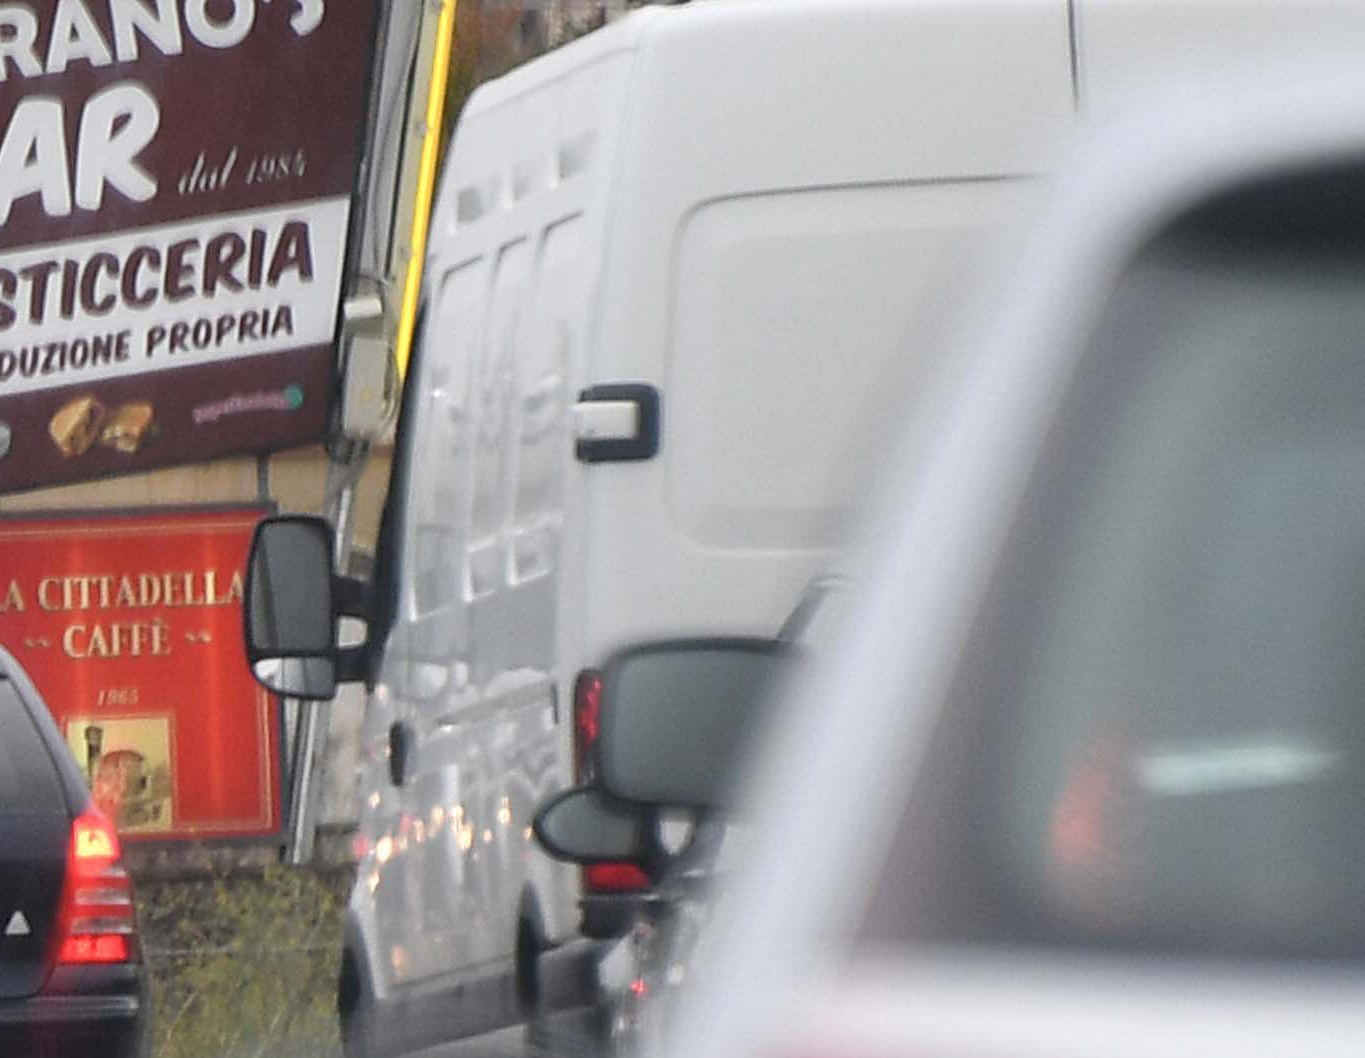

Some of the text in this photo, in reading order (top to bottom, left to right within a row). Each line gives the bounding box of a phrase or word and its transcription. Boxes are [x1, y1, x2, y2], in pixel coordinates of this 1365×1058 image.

[178, 145, 237, 195] dal
[145, 304, 294, 358] PROPRIA
[37, 570, 244, 612] CITTADELLA
[62, 617, 171, 659] CAFFÈ
